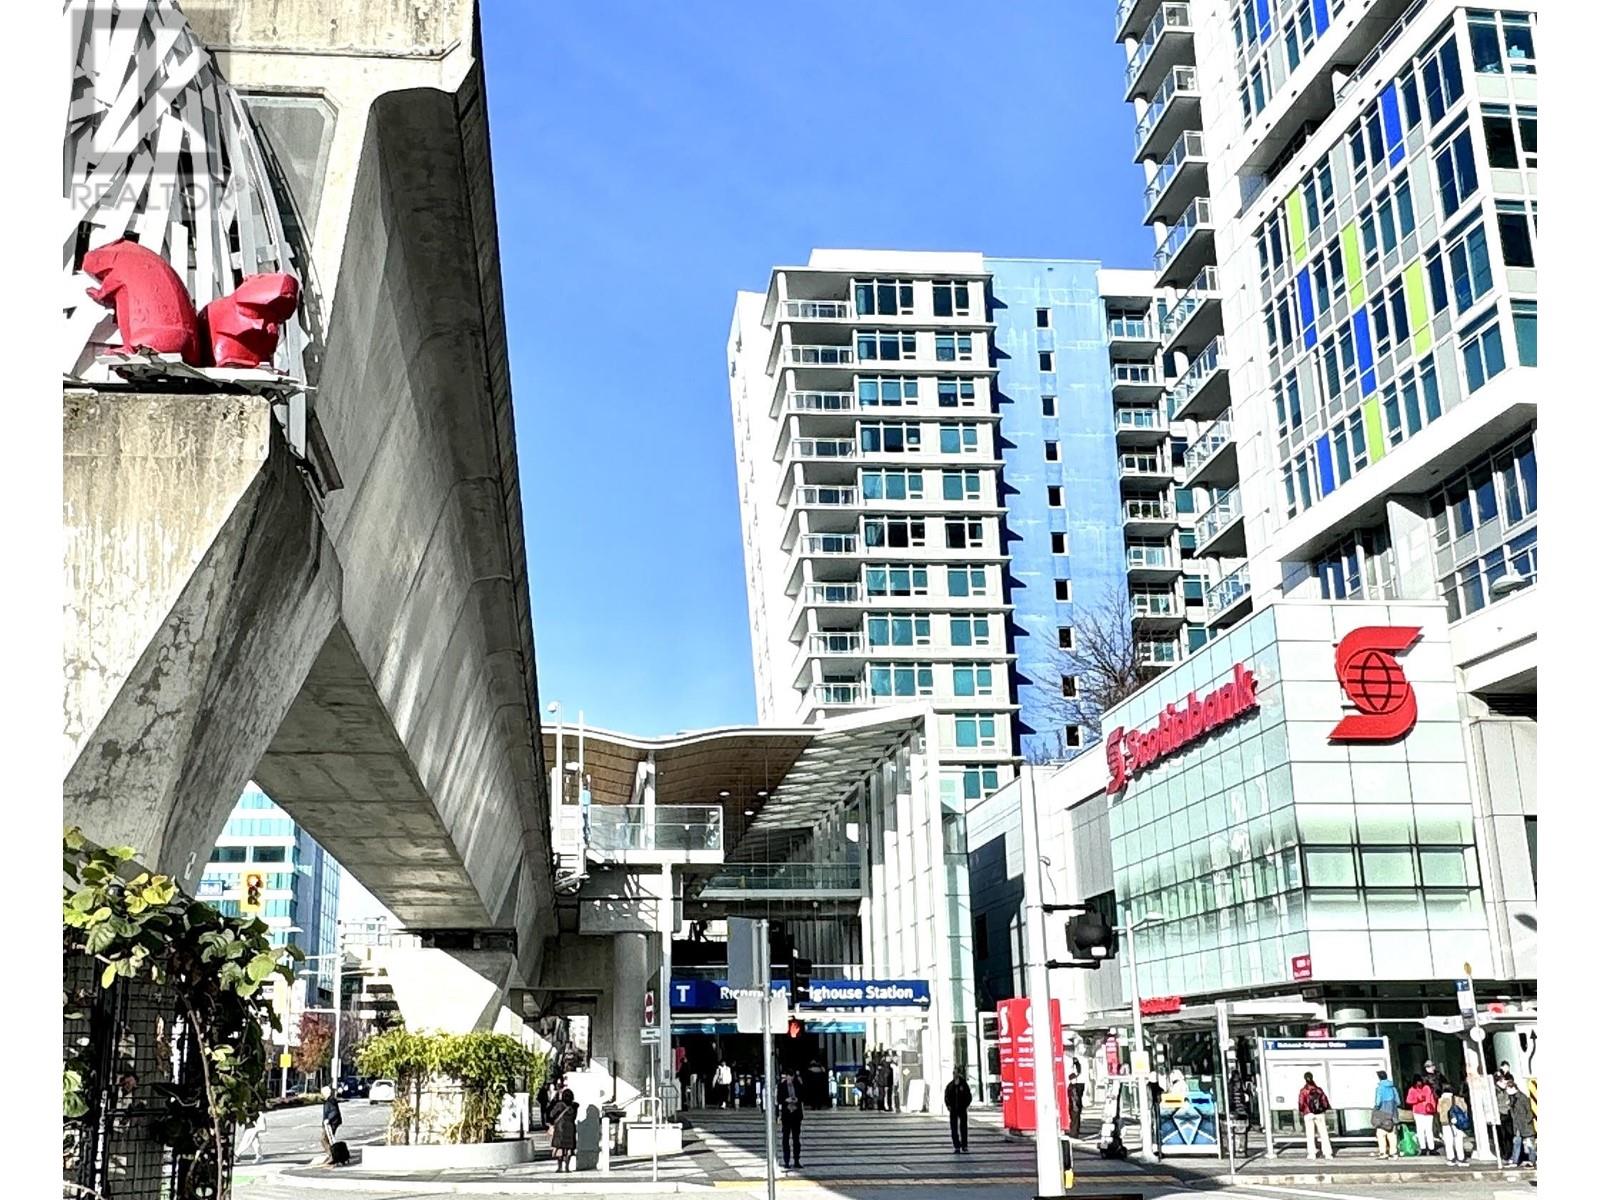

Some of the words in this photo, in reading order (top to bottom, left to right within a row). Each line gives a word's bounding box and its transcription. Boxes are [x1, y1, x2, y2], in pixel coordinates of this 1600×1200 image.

[1126, 662, 1258, 772] Scotiabank
[675, 985, 690, 1002] T
[865, 985, 914, 999] Station
